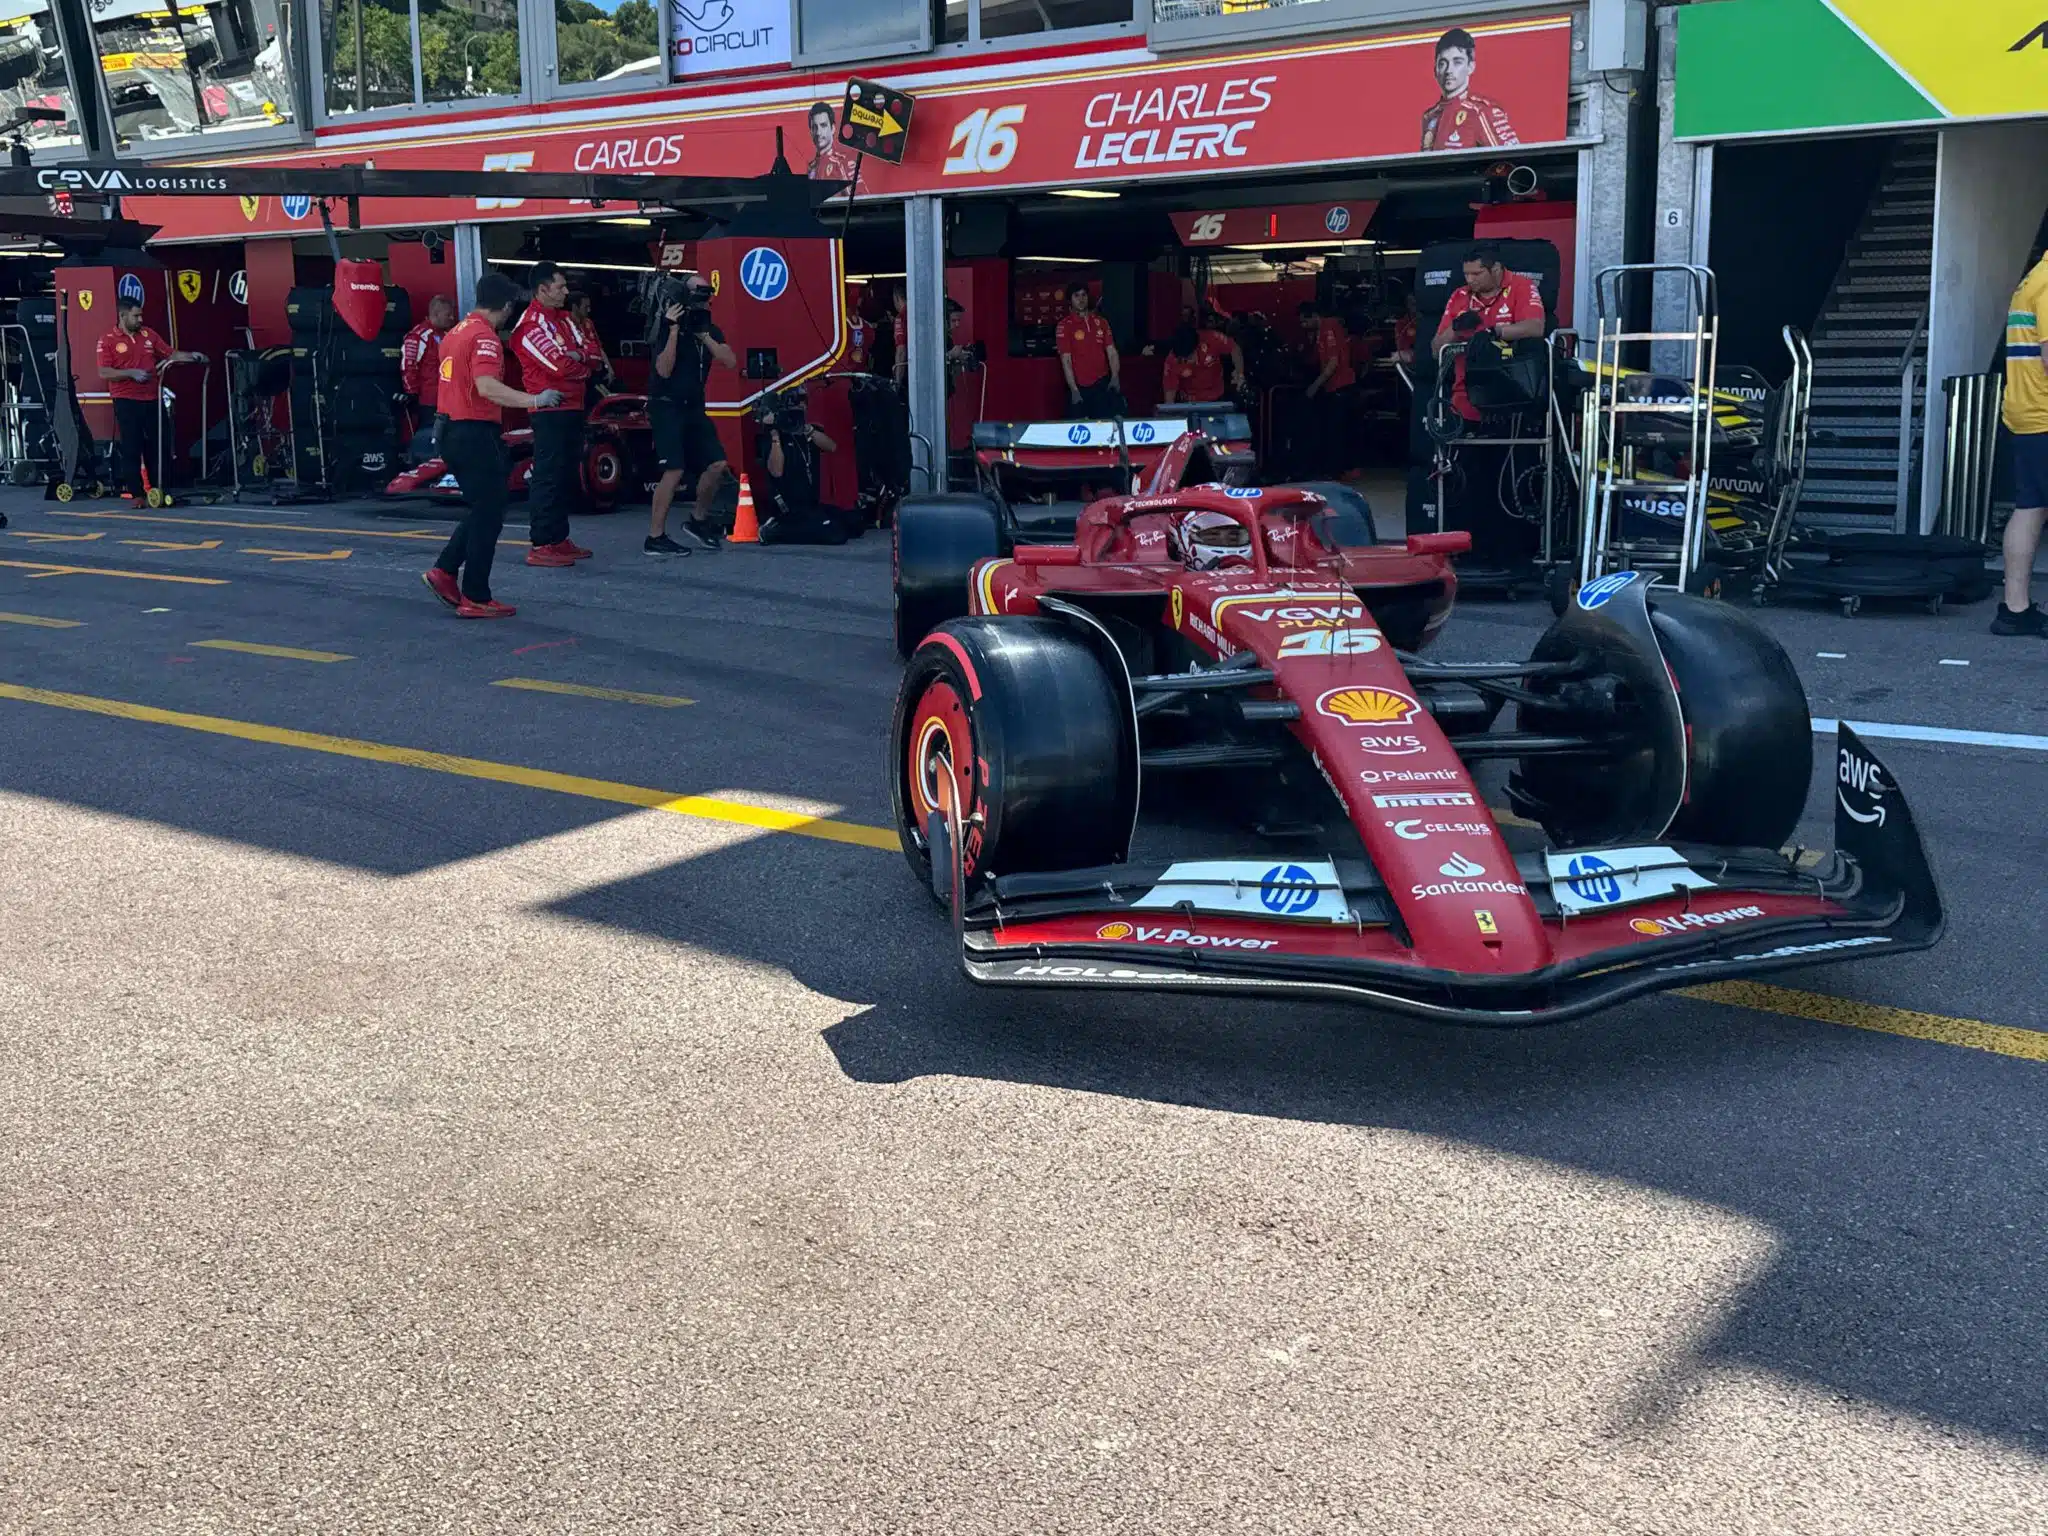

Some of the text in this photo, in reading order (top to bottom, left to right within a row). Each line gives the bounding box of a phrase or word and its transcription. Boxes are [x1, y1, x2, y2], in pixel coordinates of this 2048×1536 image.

[695, 27, 774, 54] CIRCUIT
[1084, 75, 1277, 128] CHARLES
[943, 104, 1027, 175] 16
[1074, 120, 1256, 168] LECLERC
[573, 134, 685, 171] CARLOS
[136, 178, 228, 190] LOGISTICS
[1189, 206, 1349, 241] 16 hp
[1668, 211, 1678, 225] 6
[661, 243, 685, 266] 55
[747, 248, 783, 300] hp
[1070, 423, 1153, 444] hp hp
[362, 452, 385, 464] aws
[1135, 498, 1178, 508] TECHNOLOGY
[1238, 607, 1363, 621] VGW
[1275, 618, 1347, 629] PLAY
[1189, 612, 1217, 644] RICHARD
[1216, 634, 1237, 657] MILLE
[1277, 628, 1384, 660] 16
[1360, 735, 1420, 748] aws
[1383, 769, 1458, 782] Palantir
[1839, 748, 1882, 800] aws
[1371, 792, 1476, 808] PIRELLI
[1425, 823, 1491, 833] CELSIUS
[1265, 864, 1315, 913] hp
[1411, 880, 1527, 900] Santander
[1573, 855, 1616, 903] hp
[1656, 905, 1766, 932] V-Power
[1135, 926, 1279, 951] V-Power
